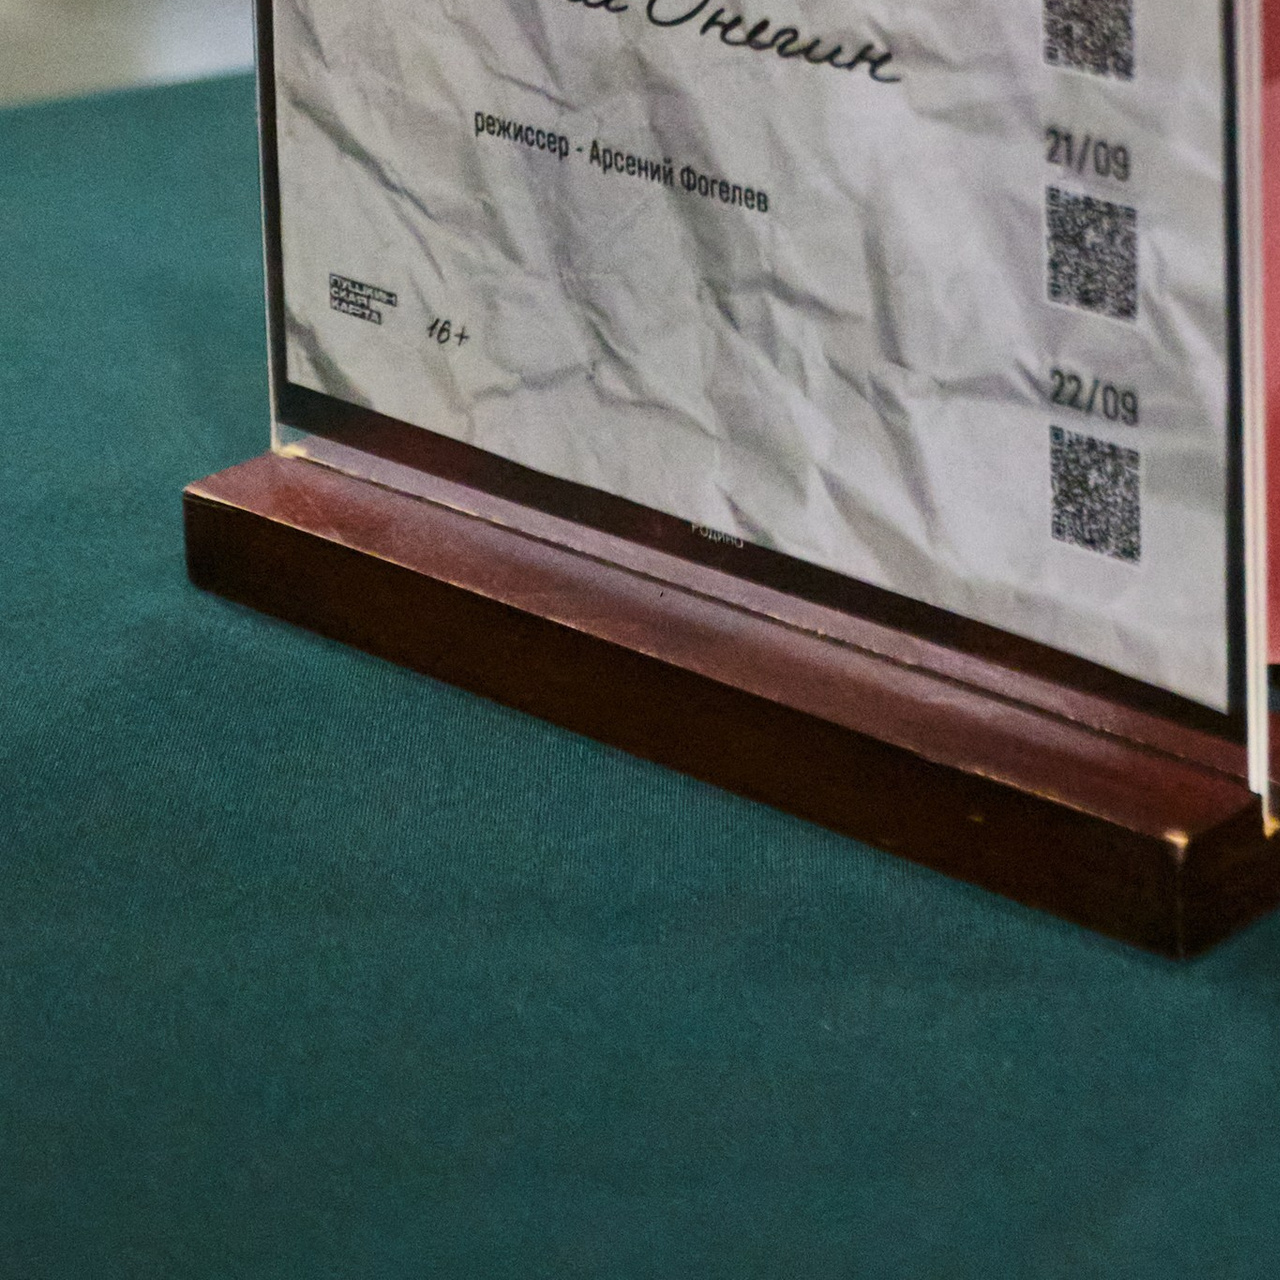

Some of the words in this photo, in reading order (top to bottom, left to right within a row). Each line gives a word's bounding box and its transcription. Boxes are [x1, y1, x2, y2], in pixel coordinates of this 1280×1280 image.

[474, 111, 569, 160] режиссер
[589, 139, 674, 187] Арсений
[679, 165, 769, 213] Фогелев
[1046, 125, 1131, 181] 21/09
[427, 318, 470, 346] 16+
[1050, 368, 1139, 427] 22/09
